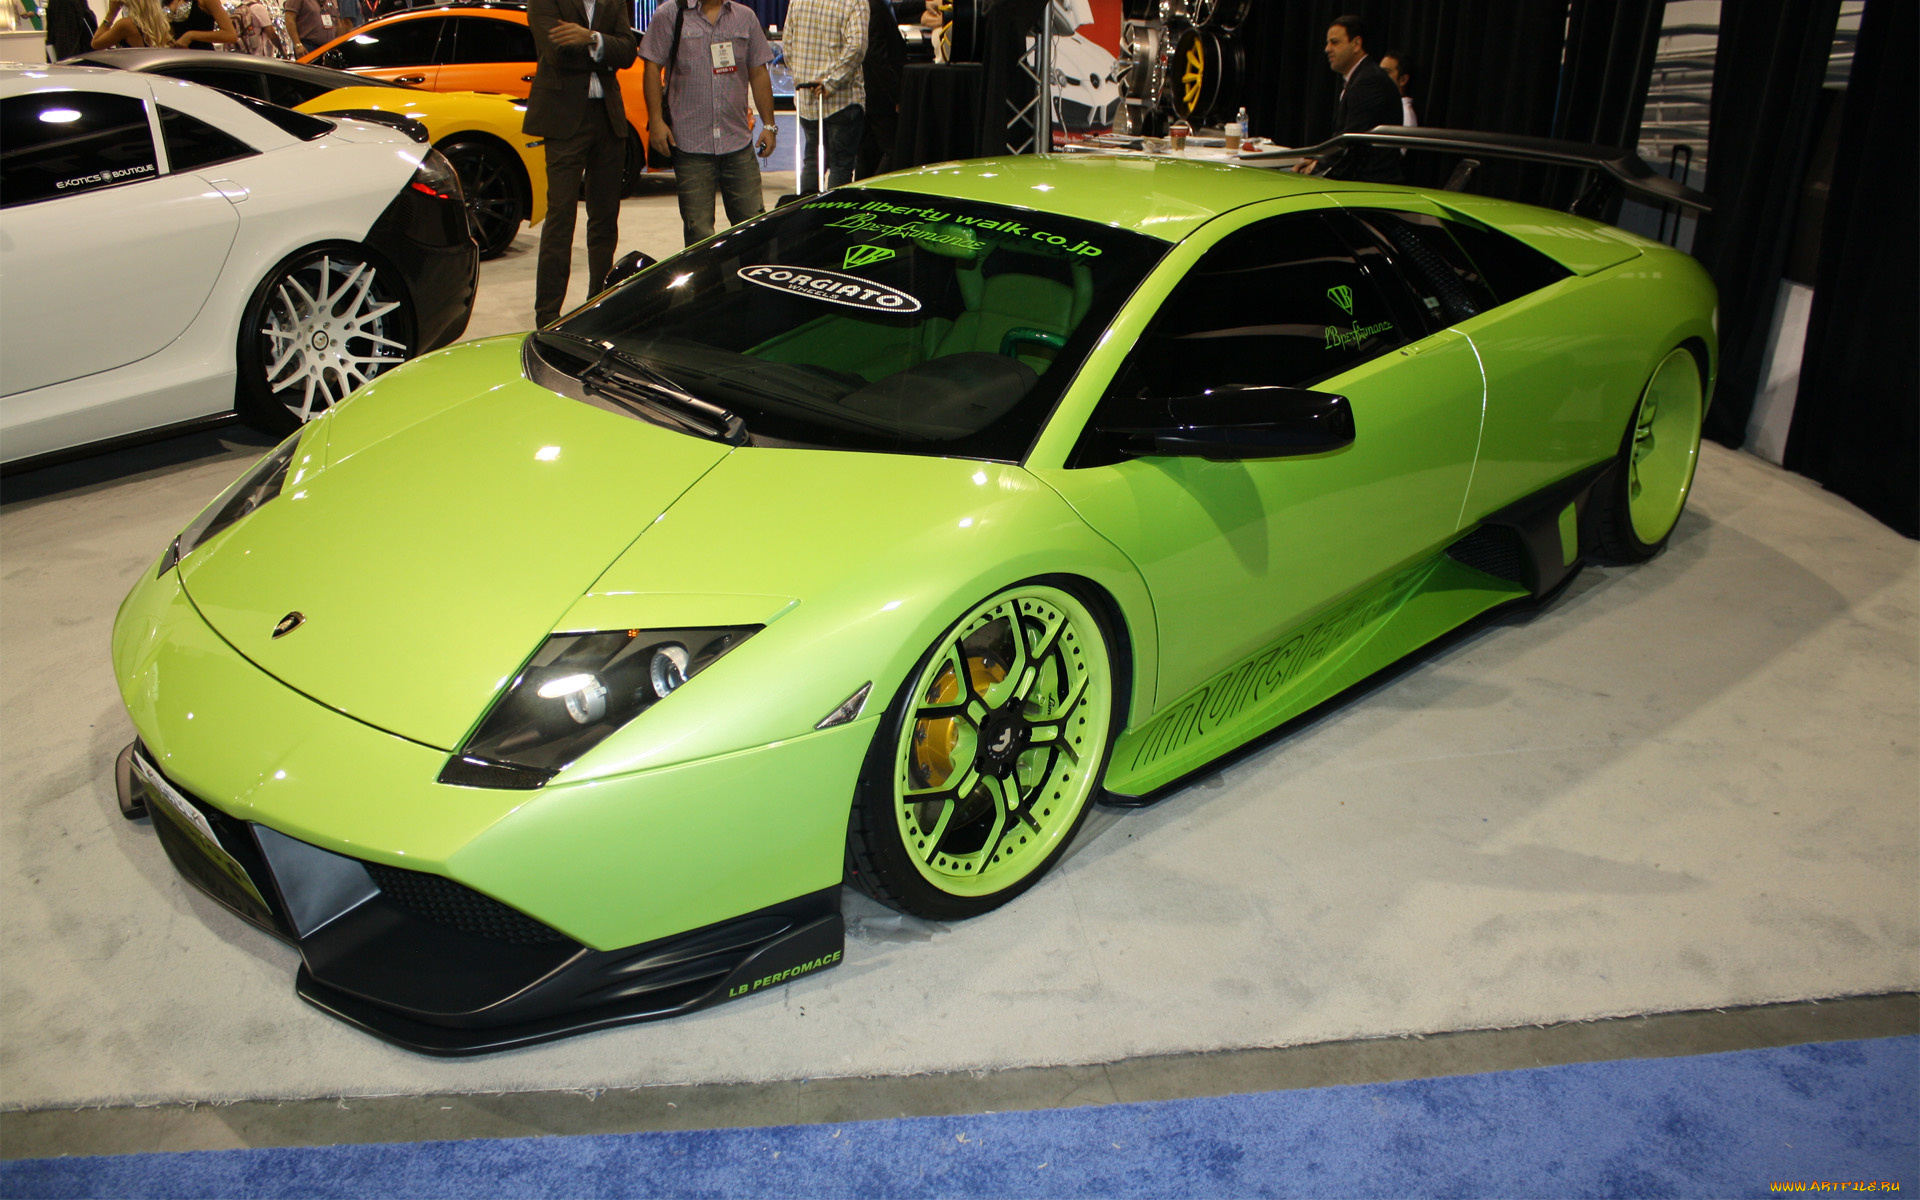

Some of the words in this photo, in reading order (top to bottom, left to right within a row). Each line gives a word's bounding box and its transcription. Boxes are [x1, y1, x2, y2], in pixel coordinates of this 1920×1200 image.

[55, 174, 101, 189] EXOTICS
[112, 164, 155, 178] BOUTIQUE
[802, 200, 950, 223] www.liberty
[955, 212, 1103, 257] walk.co.jp
[747, 267, 904, 307] FORGIATO
[787, 284, 840, 299] WHEELS
[728, 983, 749, 998] LB
[752, 950, 842, 990] PERFOMACE
